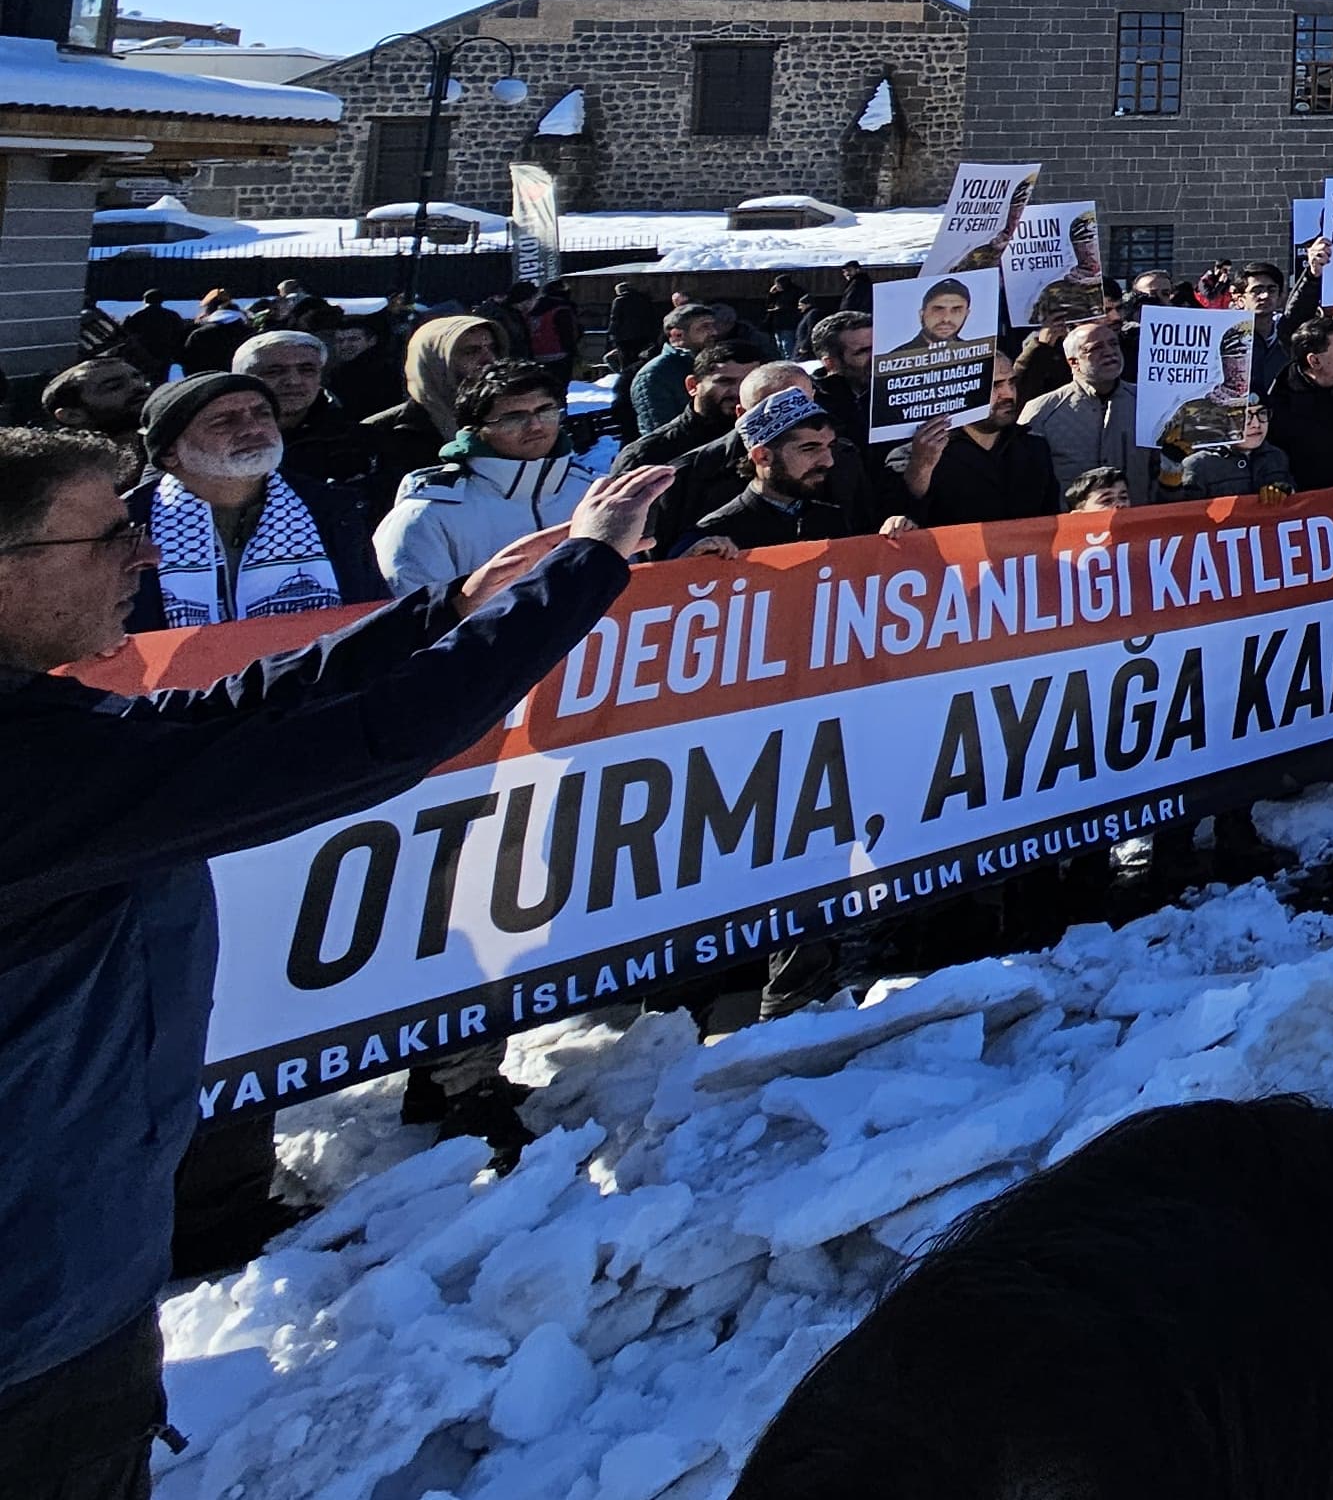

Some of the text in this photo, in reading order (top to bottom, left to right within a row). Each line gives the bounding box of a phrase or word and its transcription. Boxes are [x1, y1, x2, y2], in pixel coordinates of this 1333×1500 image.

[960, 179, 1011, 199] YOLUN
[955, 202, 1003, 215] YOLUMUZ
[947, 216, 998, 234] EY ŞEHİT!
[1016, 218, 1061, 240] OLUN
[1008, 239, 1062, 256] YOLUMUZ
[1011, 254, 1063, 273] EY ŞEHİT!
[1150, 323, 1211, 347] YOLUN
[878, 343, 992, 373] GAZZE'DE DAĞ YOKTUR.
[1149, 348, 1208, 365] YOLUMUZ
[887, 362, 984, 391] GAZZE'NİN DAĞLARI
[1148, 366, 1208, 385] EY ŞEHİT!
[889, 378, 981, 406] CESURCA SAVAŞAN
[556, 577, 786, 719] DEĞİL
[809, 531, 1131, 670] İNSANLIĞI
[286, 717, 885, 991] OTURMA,
[920, 632, 1206, 824] AYAĞA
[199, 794, 1187, 1121] YARBAKIR İSLAMİ SİVİL TOPLUM KURULUŞLARI
